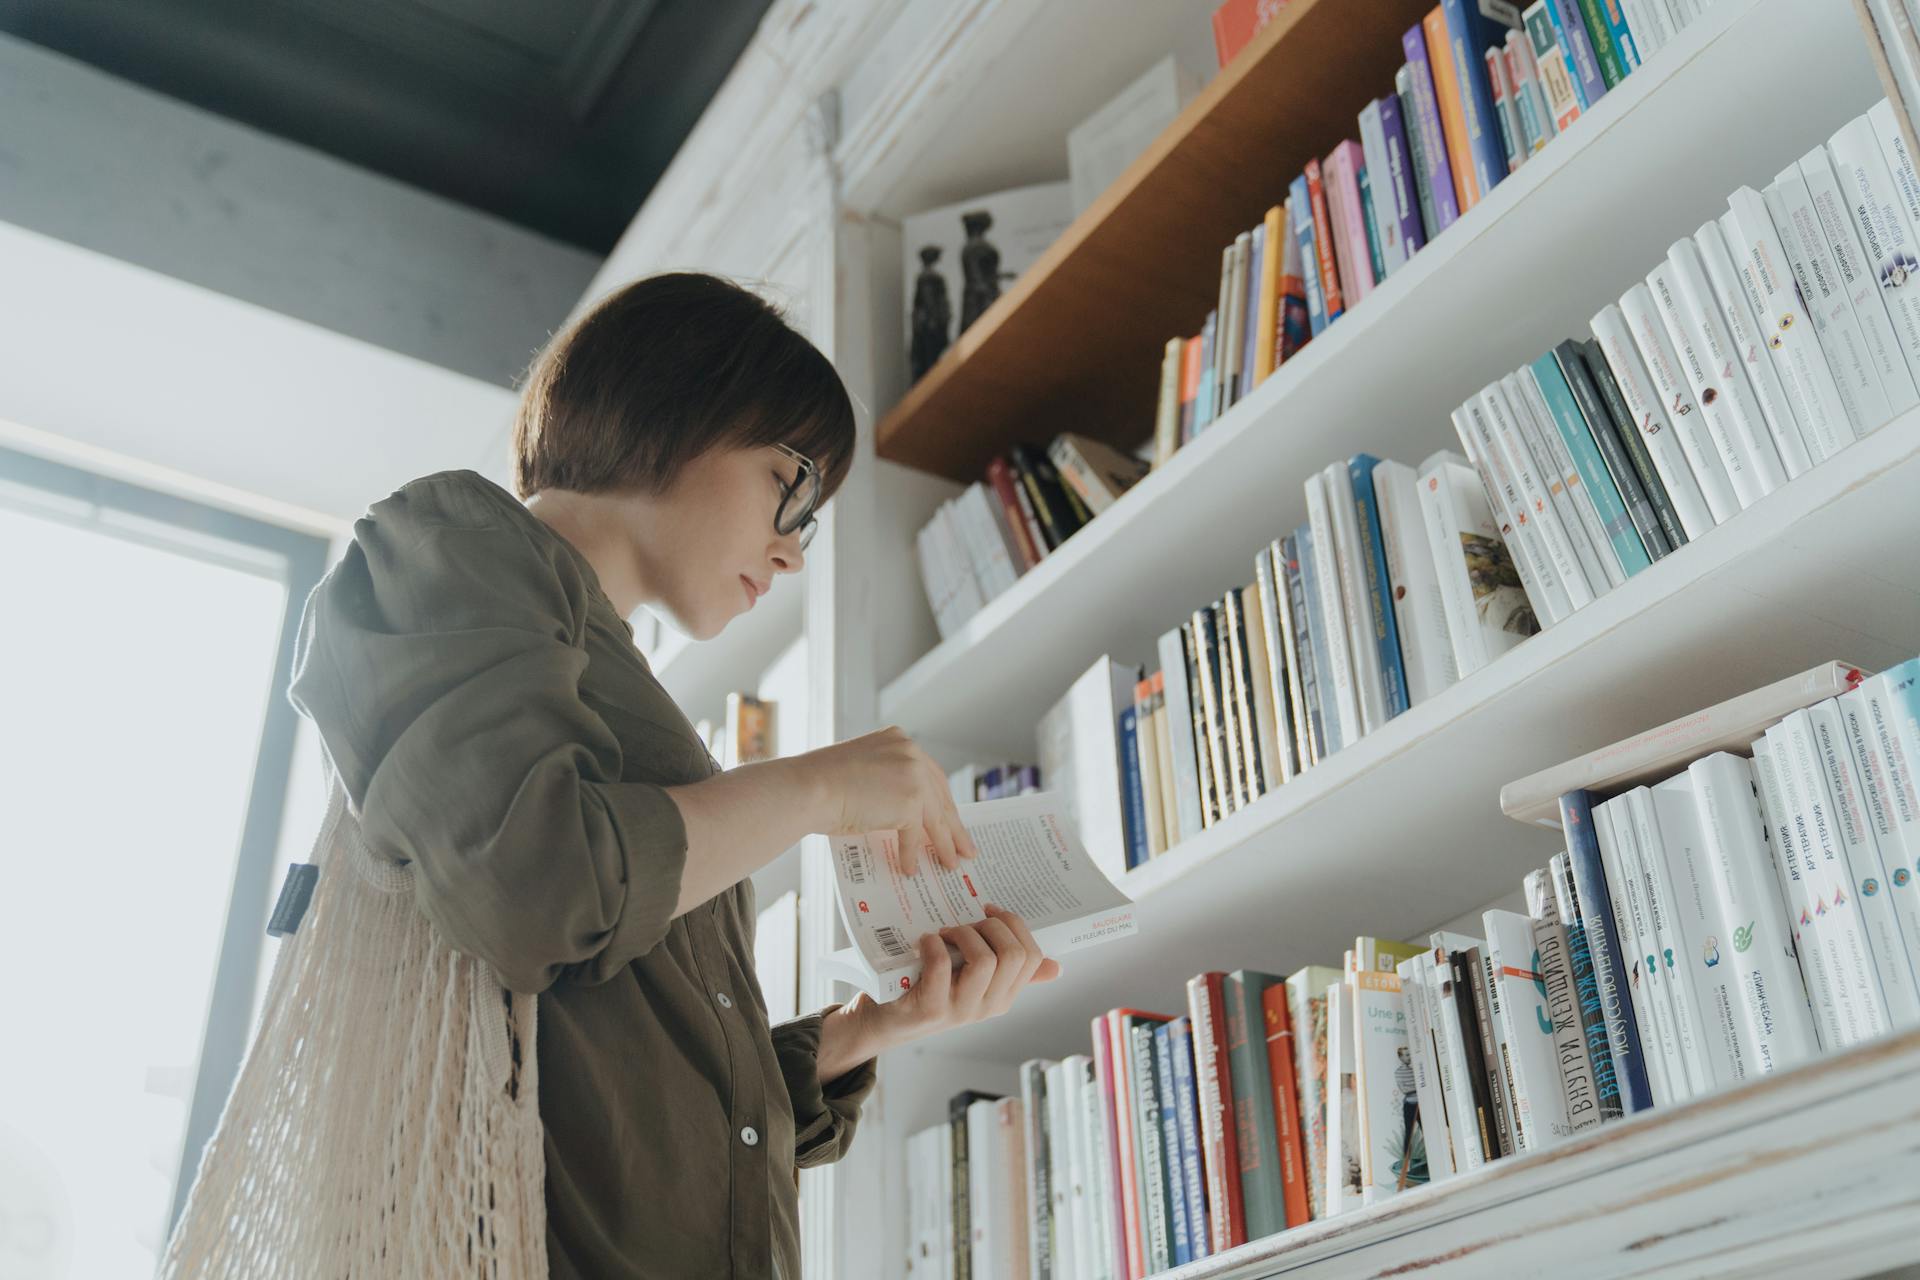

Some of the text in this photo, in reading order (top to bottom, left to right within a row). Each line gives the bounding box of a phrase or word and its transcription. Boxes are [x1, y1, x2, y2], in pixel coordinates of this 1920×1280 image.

[1369, 1007, 1392, 1019] Une
[1536, 935, 1577, 1034] ЖЕНЩИНЫ
[1587, 914, 1630, 1057] ИСКУССТВОТЕРАПИЯ
[1557, 1038, 1593, 1115] ВНУТРИ
[1585, 1021, 1619, 1100] ВНУТРИ
